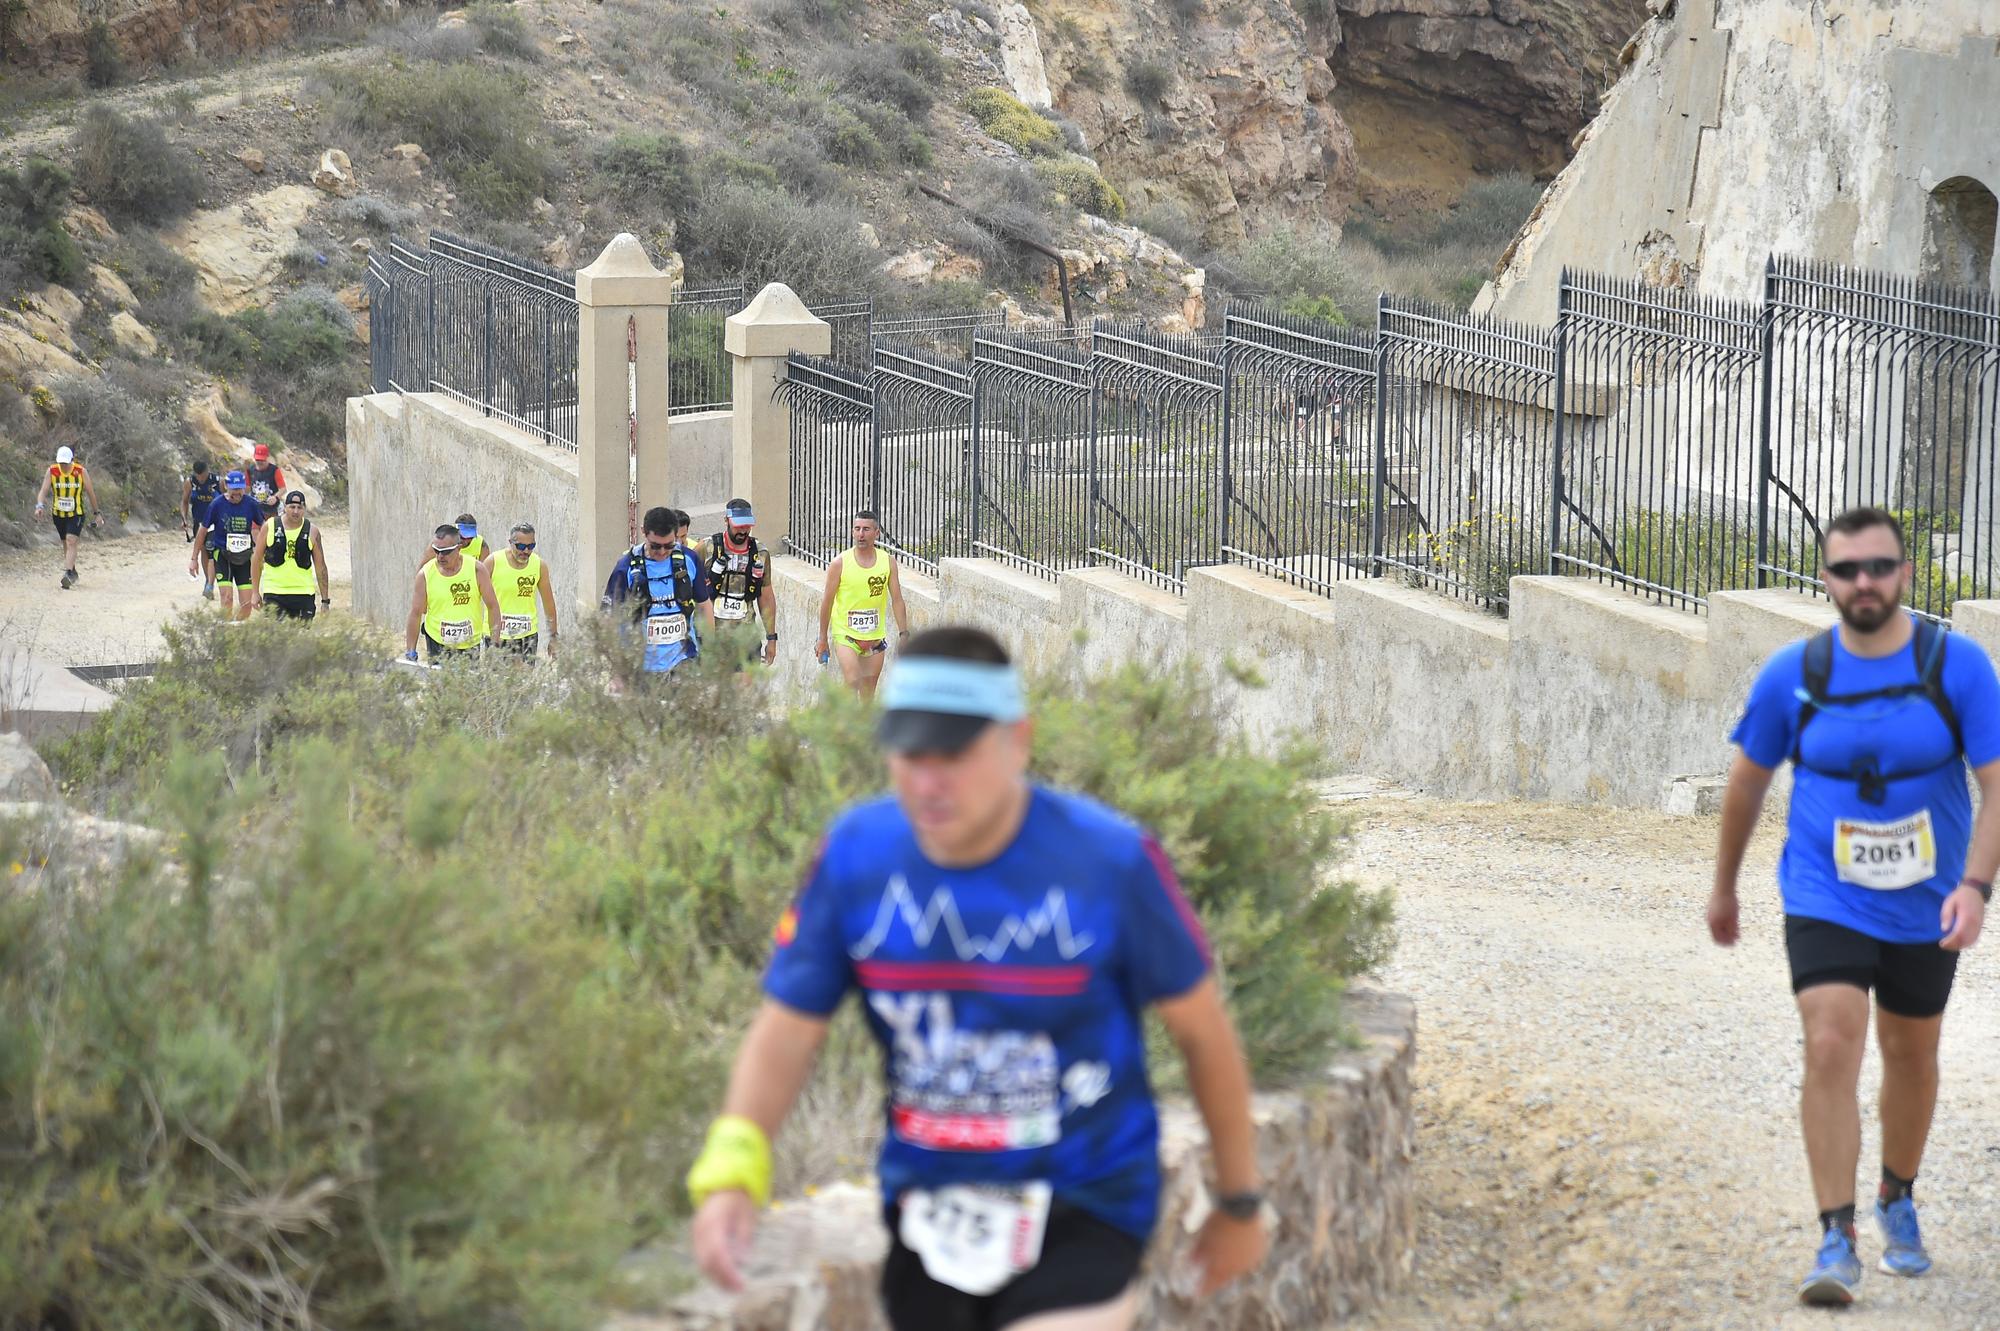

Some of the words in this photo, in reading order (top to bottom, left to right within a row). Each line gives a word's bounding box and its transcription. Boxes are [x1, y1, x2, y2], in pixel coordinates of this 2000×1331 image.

[724, 601, 741, 611] 643
[853, 616, 875, 626] 2873
[655, 624, 681, 636] 1000
[1853, 840, 1916, 864] 2061
